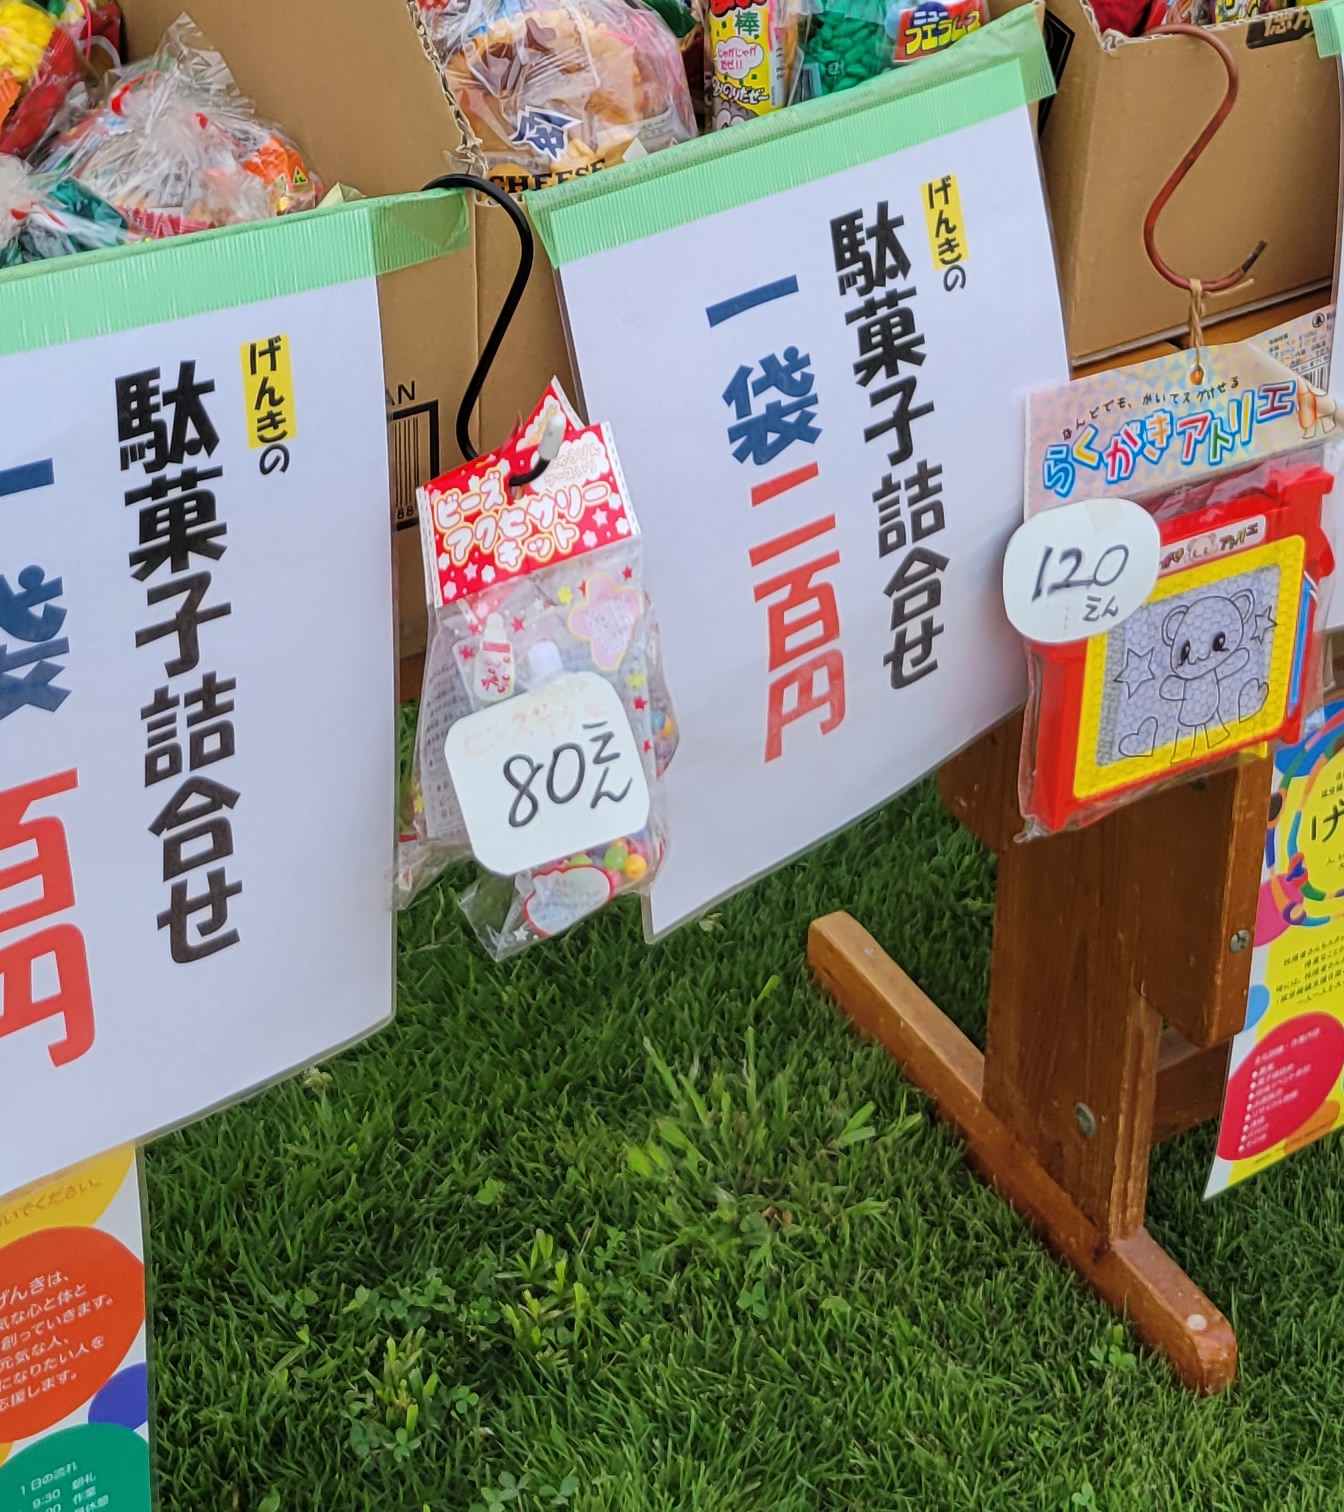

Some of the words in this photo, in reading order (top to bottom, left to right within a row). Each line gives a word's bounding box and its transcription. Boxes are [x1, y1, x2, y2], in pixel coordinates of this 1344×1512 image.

[912, 8, 949, 27] ニュー
[926, 174, 968, 293] げんきの
[248, 341, 291, 476] げんきの
[829, 199, 952, 692] 駄菓子詰合せ
[1042, 379, 1298, 498] らくがきアトリエ
[433, 468, 511, 529] ビーズ
[442, 480, 612, 566] アクセサリー
[494, 524, 580, 572] キット
[1031, 543, 1129, 603] 120
[1082, 592, 1119, 622] えん
[115, 359, 244, 965] 駄菓子詰合せ
[501, 719, 634, 829] 80えん
